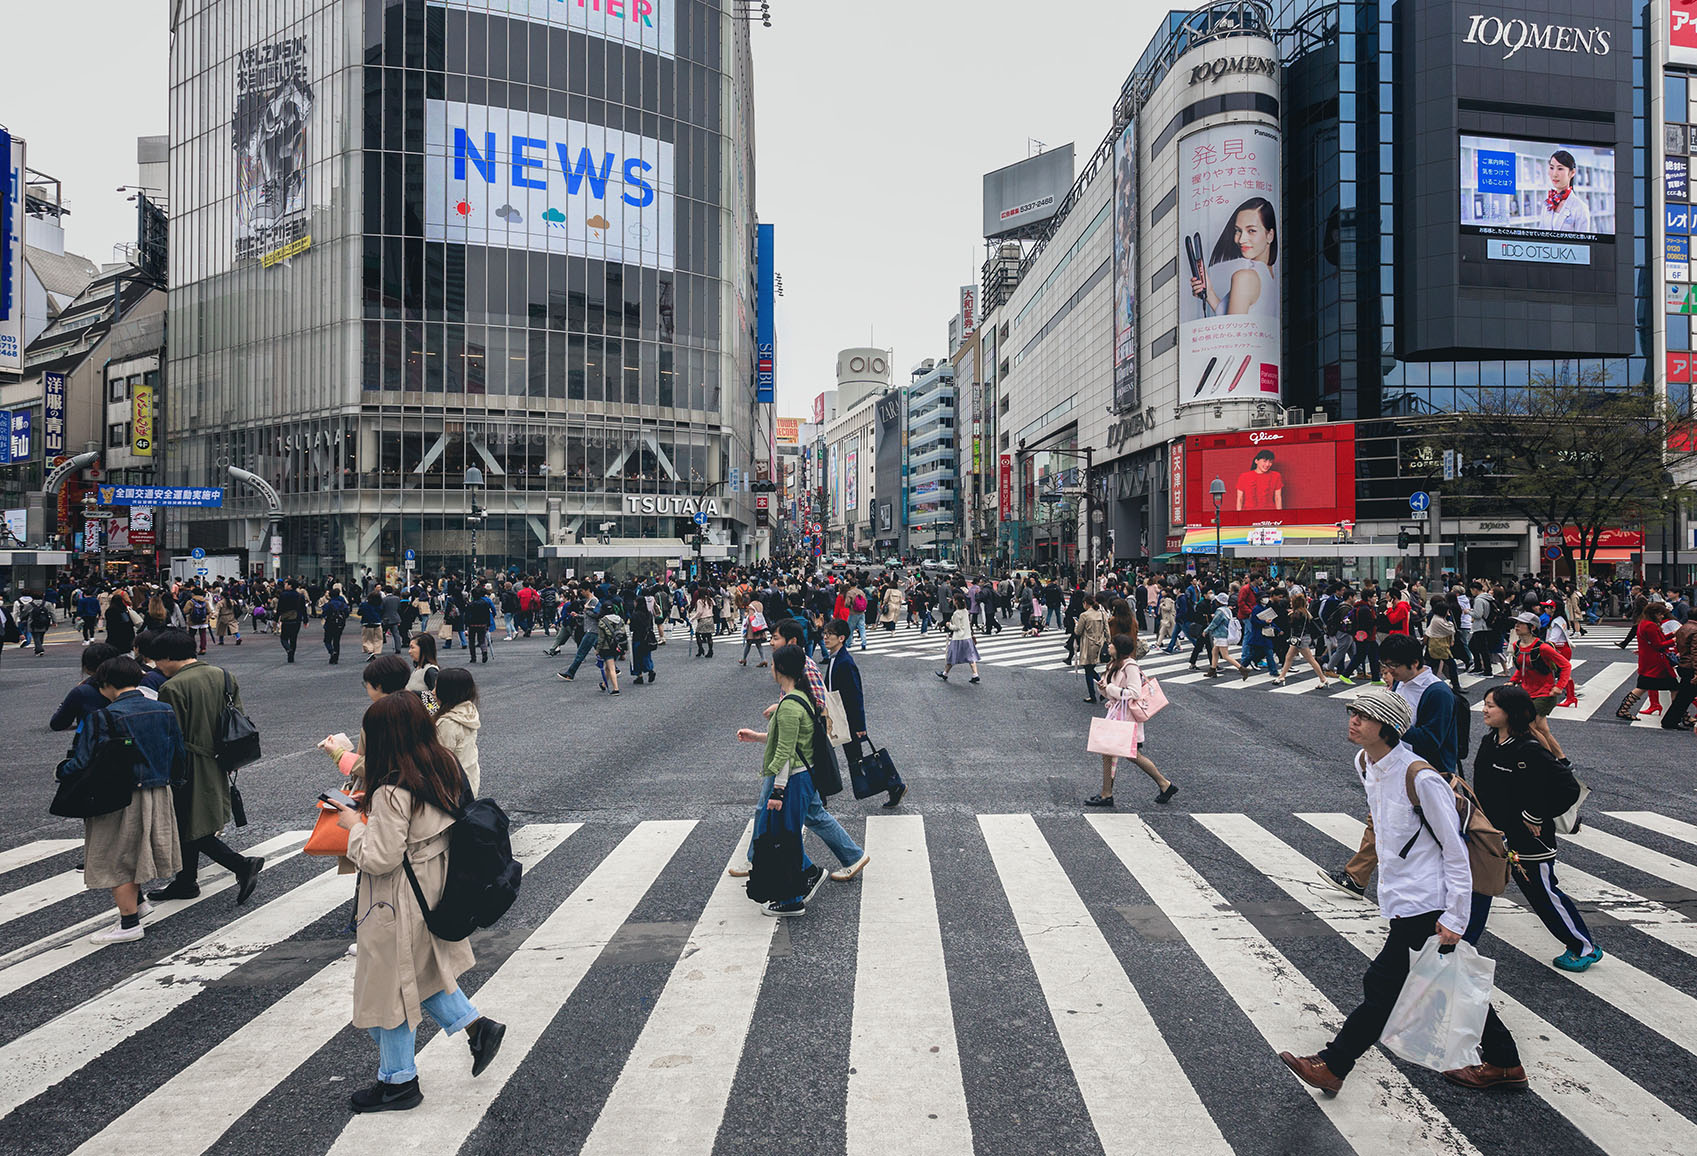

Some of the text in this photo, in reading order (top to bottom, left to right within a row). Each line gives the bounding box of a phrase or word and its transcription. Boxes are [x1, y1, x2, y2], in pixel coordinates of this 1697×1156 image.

[1462, 14, 1611, 60] 109MEN'S
[1254, 129, 1279, 142] Panasonic
[1191, 138, 1256, 170] 発見。
[454, 127, 654, 208] NEWS
[1482, 168, 1510, 177] 気をつけて
[1191, 179, 1273, 199] ストレート性能は
[1191, 195, 1230, 211] 上がる。
[1526, 245, 1576, 261] OTSUKA
[1673, 271, 1682, 279] 6F
[759, 343, 772, 391] SEIBU
[46, 376, 63, 450] 洋服の青山
[136, 439, 150, 448] 4F
[1249, 432, 1284, 445] Glico
[115, 488, 221, 500] 全国交通安全運動実施中
[627, 496, 719, 515] TSUTAYA
